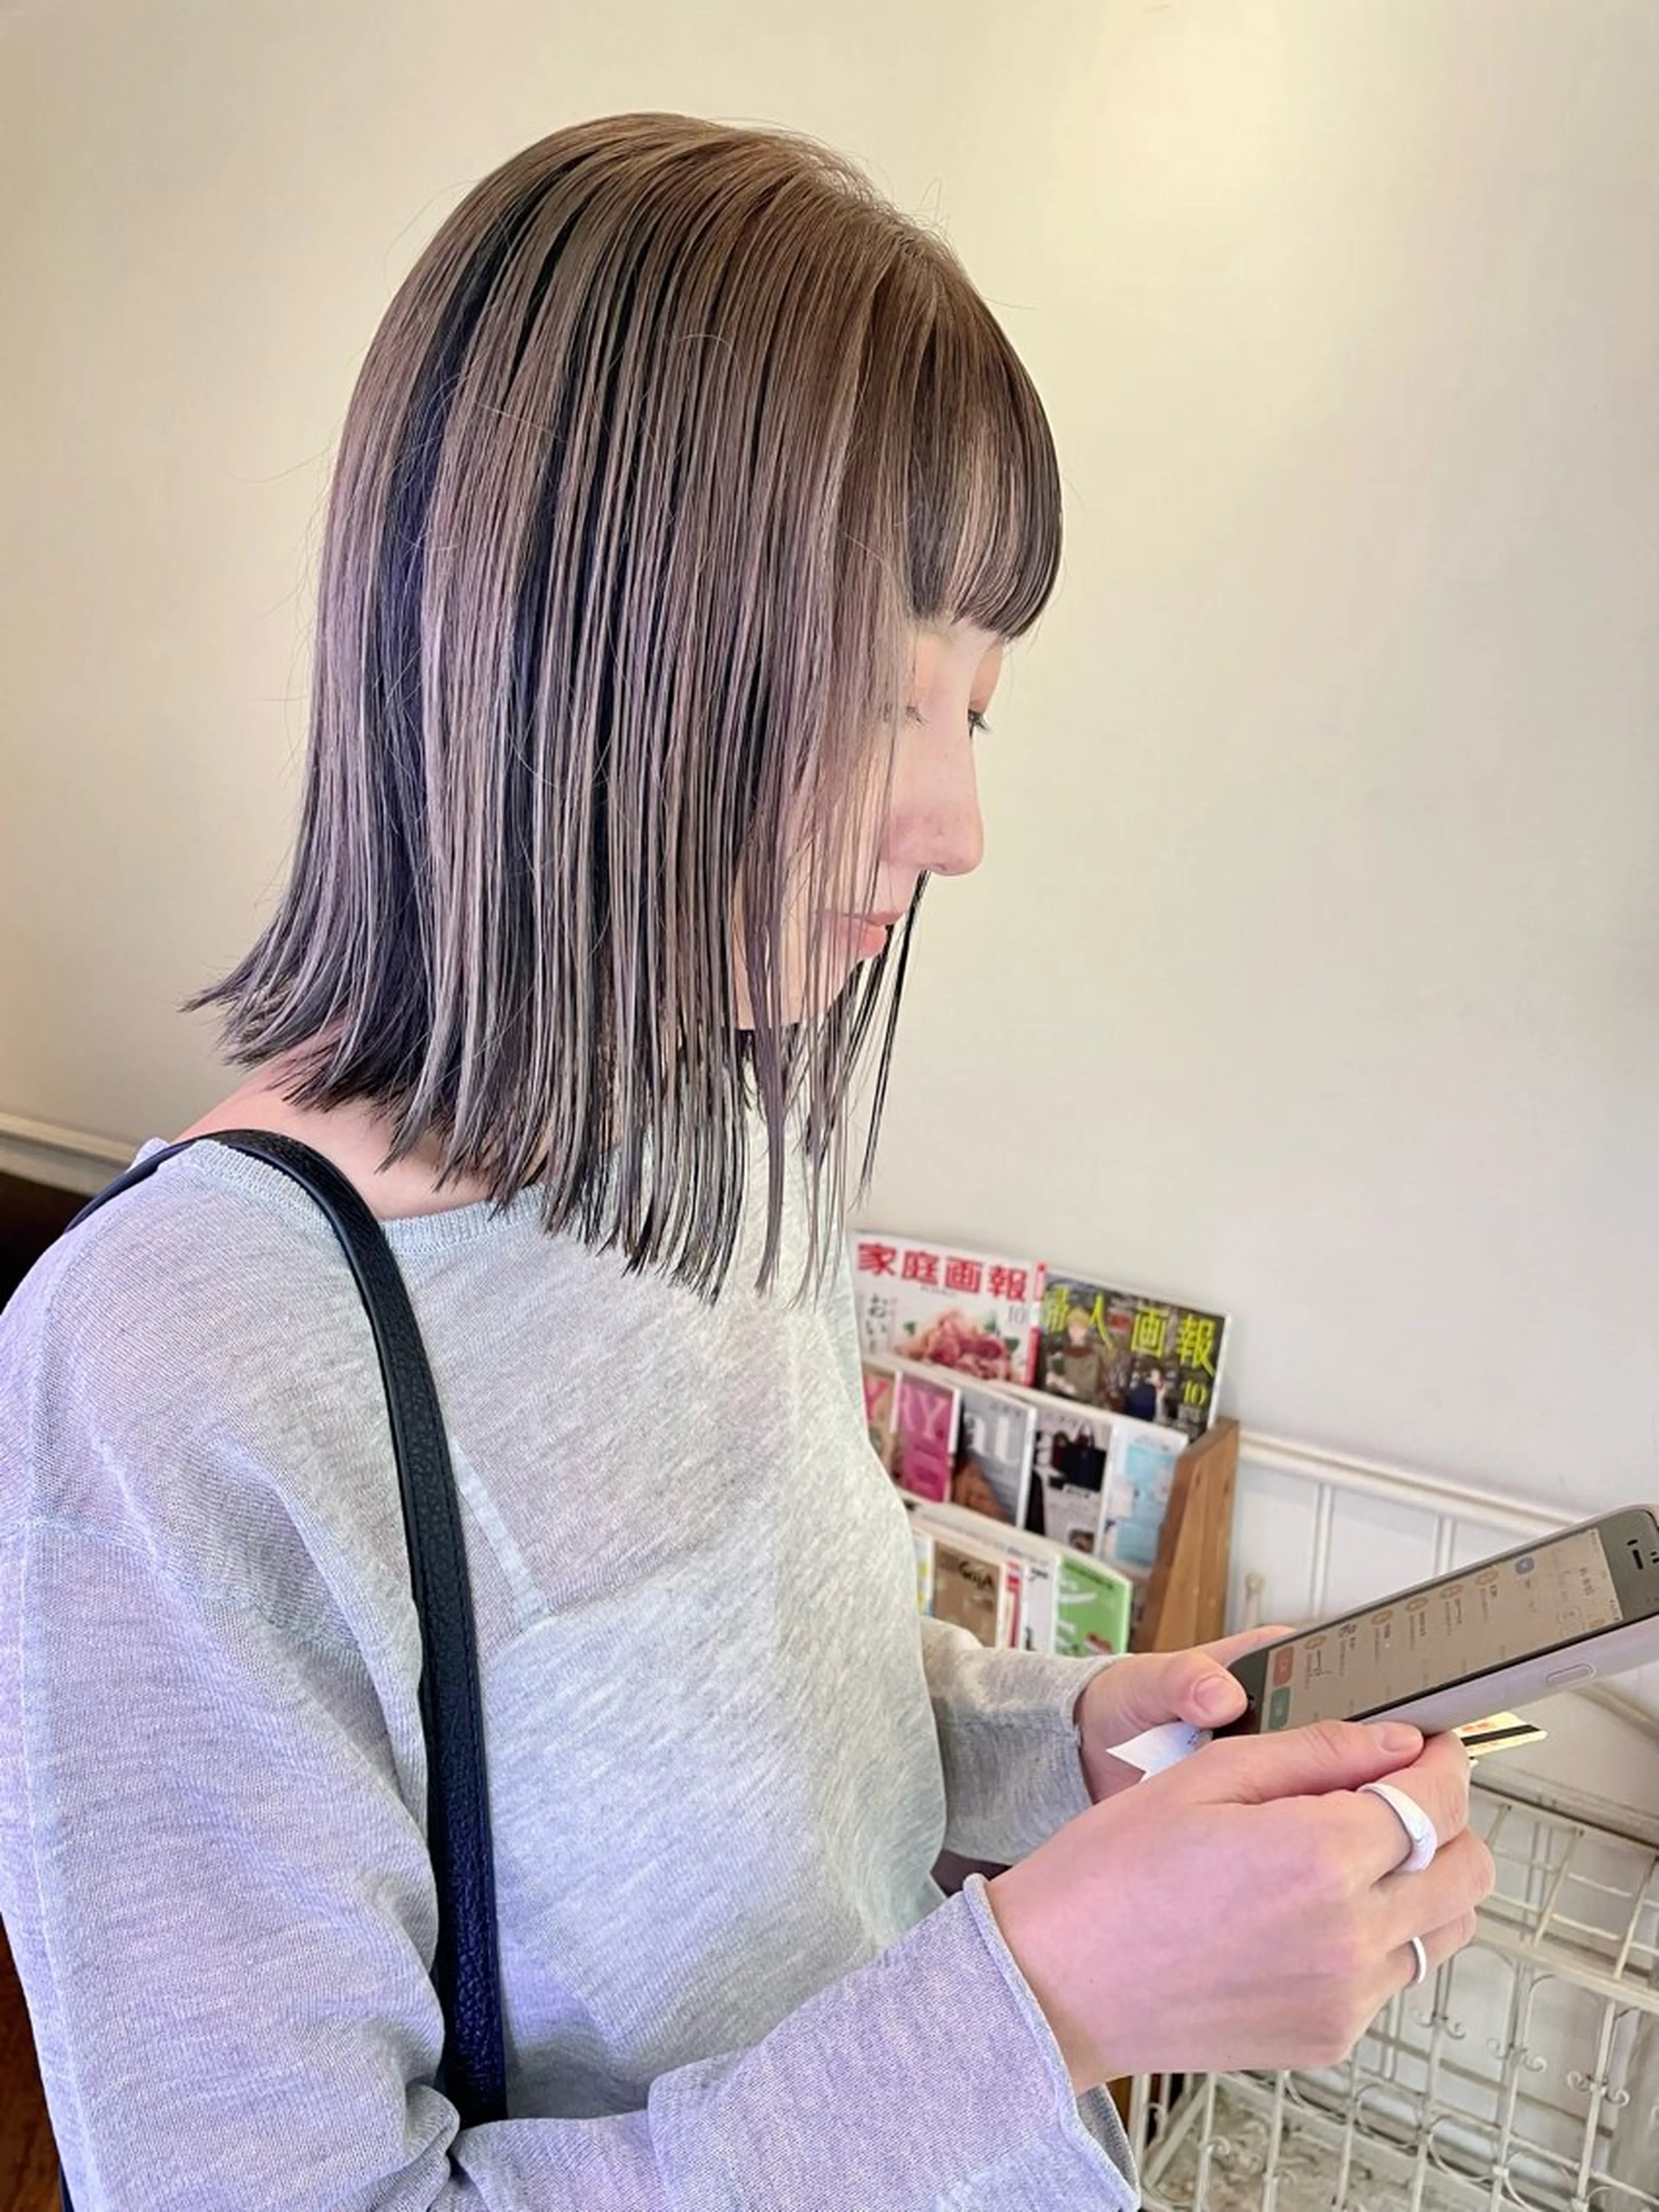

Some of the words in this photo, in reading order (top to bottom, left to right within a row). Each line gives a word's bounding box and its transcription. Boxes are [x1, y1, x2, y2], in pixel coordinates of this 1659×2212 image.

[858, 1243, 1028, 1302] 家庭画報
[1184, 1381, 1207, 1405] 10
